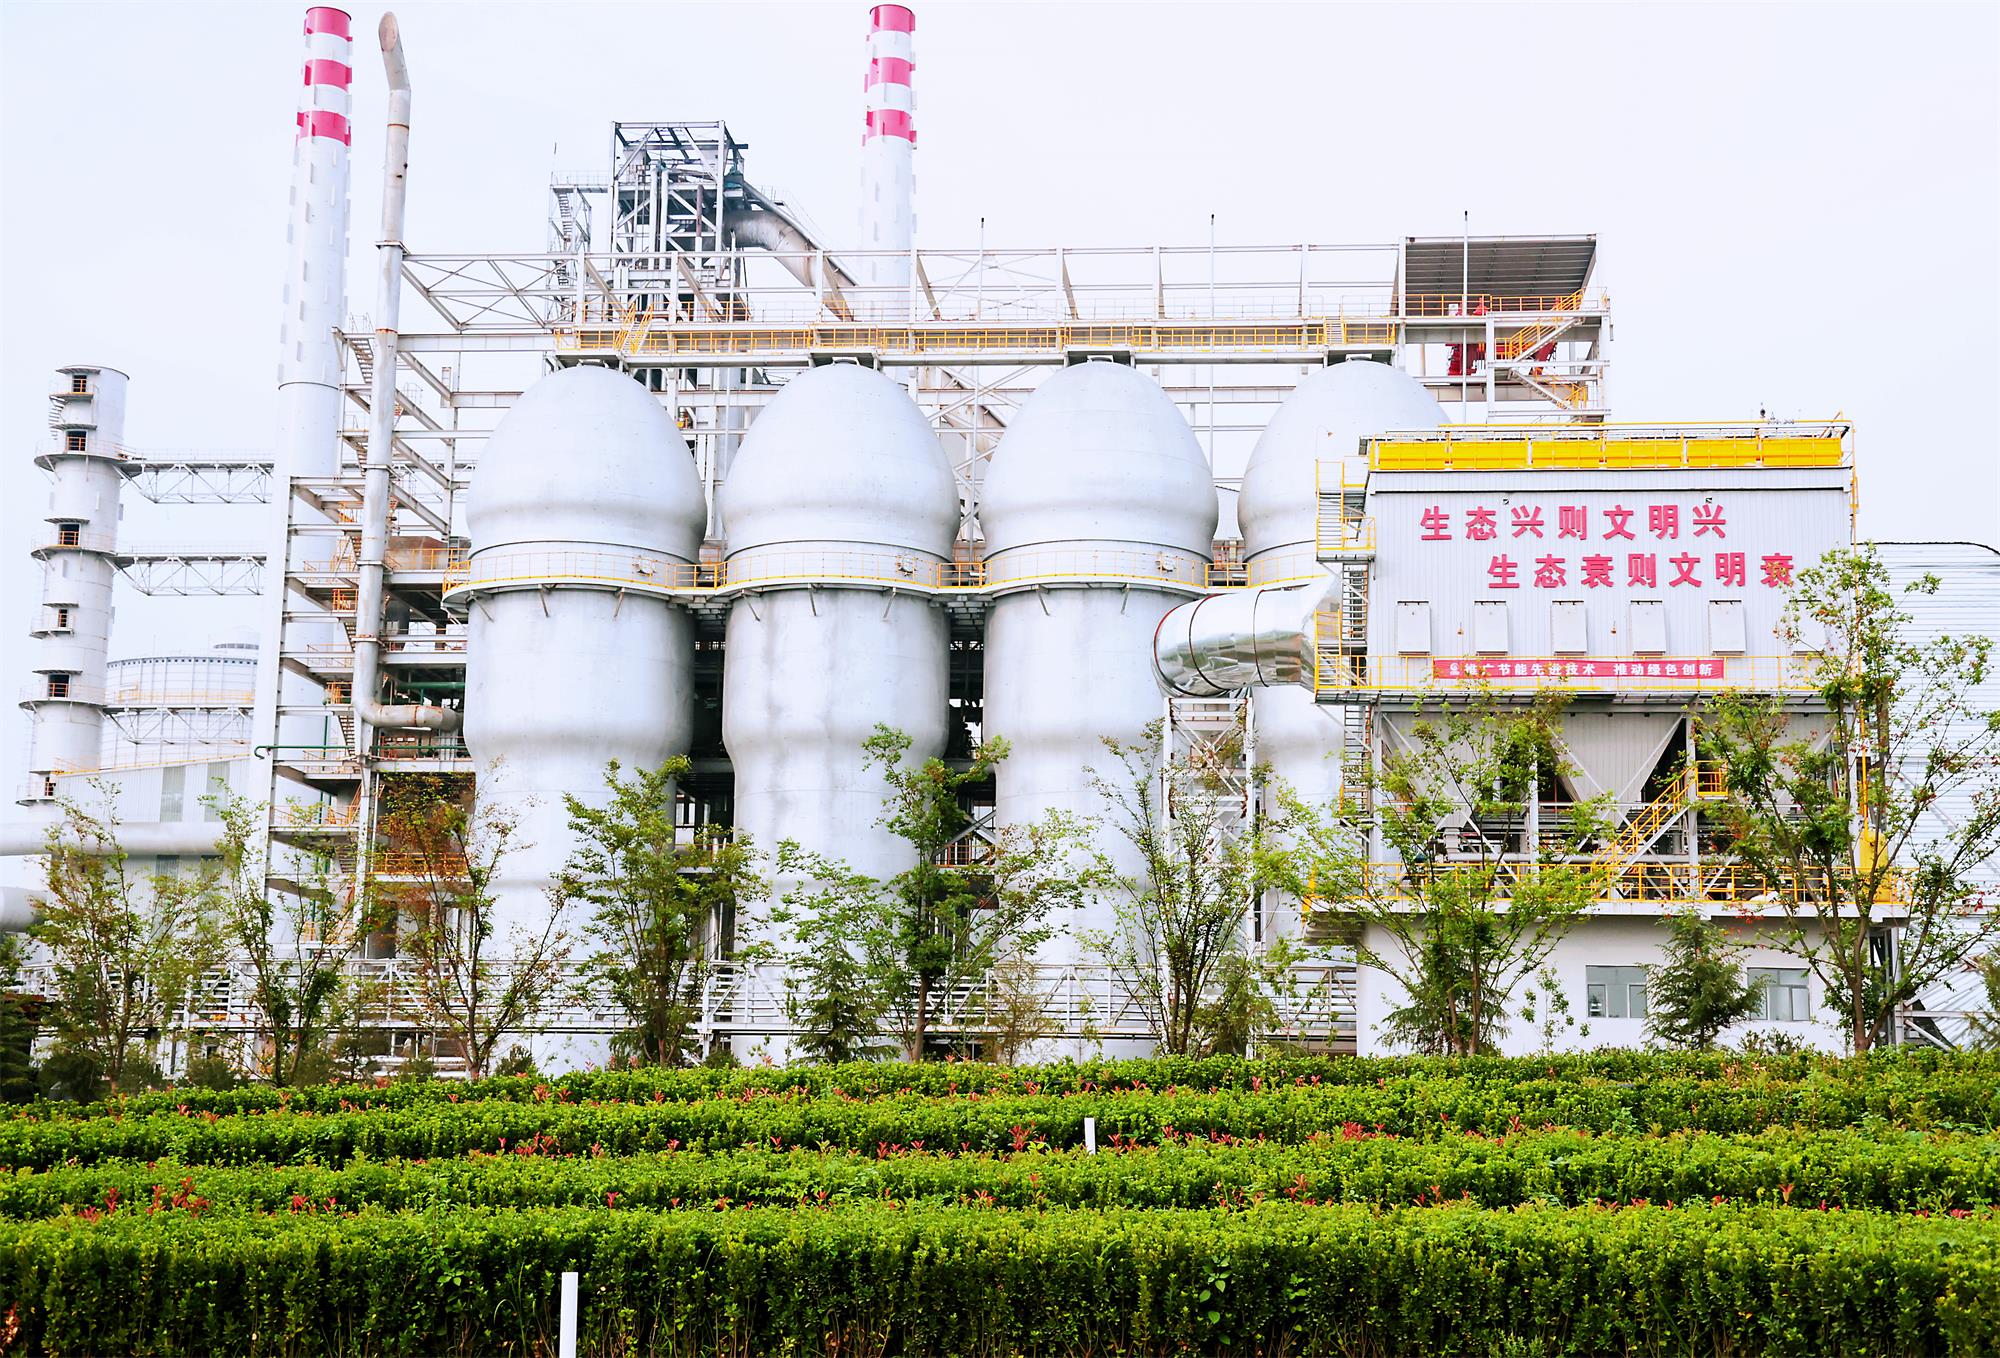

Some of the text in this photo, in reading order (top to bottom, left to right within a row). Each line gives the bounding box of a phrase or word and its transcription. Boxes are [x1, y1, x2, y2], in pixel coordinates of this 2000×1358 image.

[1420, 504, 1726, 541] 生态兴则文明兴
[1487, 551, 1794, 589] 生态衰则文明衰
[1613, 663, 1713, 676] 推动绿色创新
